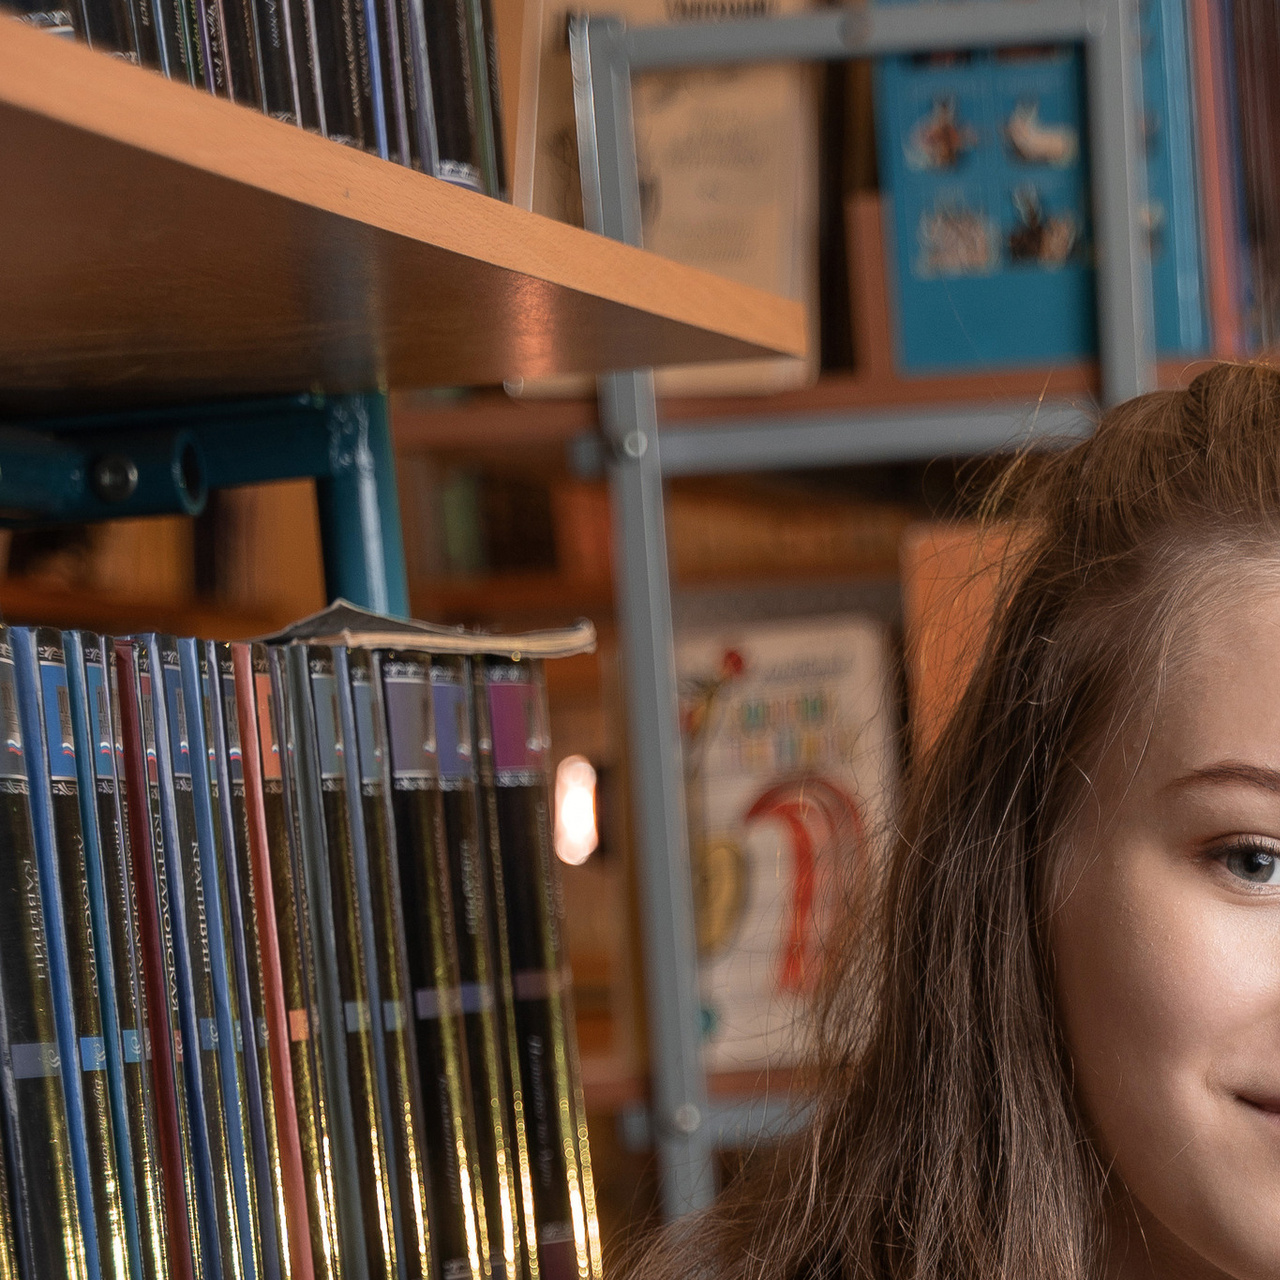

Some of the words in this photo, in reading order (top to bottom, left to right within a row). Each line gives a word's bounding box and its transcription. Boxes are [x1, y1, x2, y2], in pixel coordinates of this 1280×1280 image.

[23, 859, 46, 980] КАВЕРИН
[154, 813, 180, 1011] КОНЧАЛОВСКАЯ
[192, 840, 211, 974] КРАПИВИН
